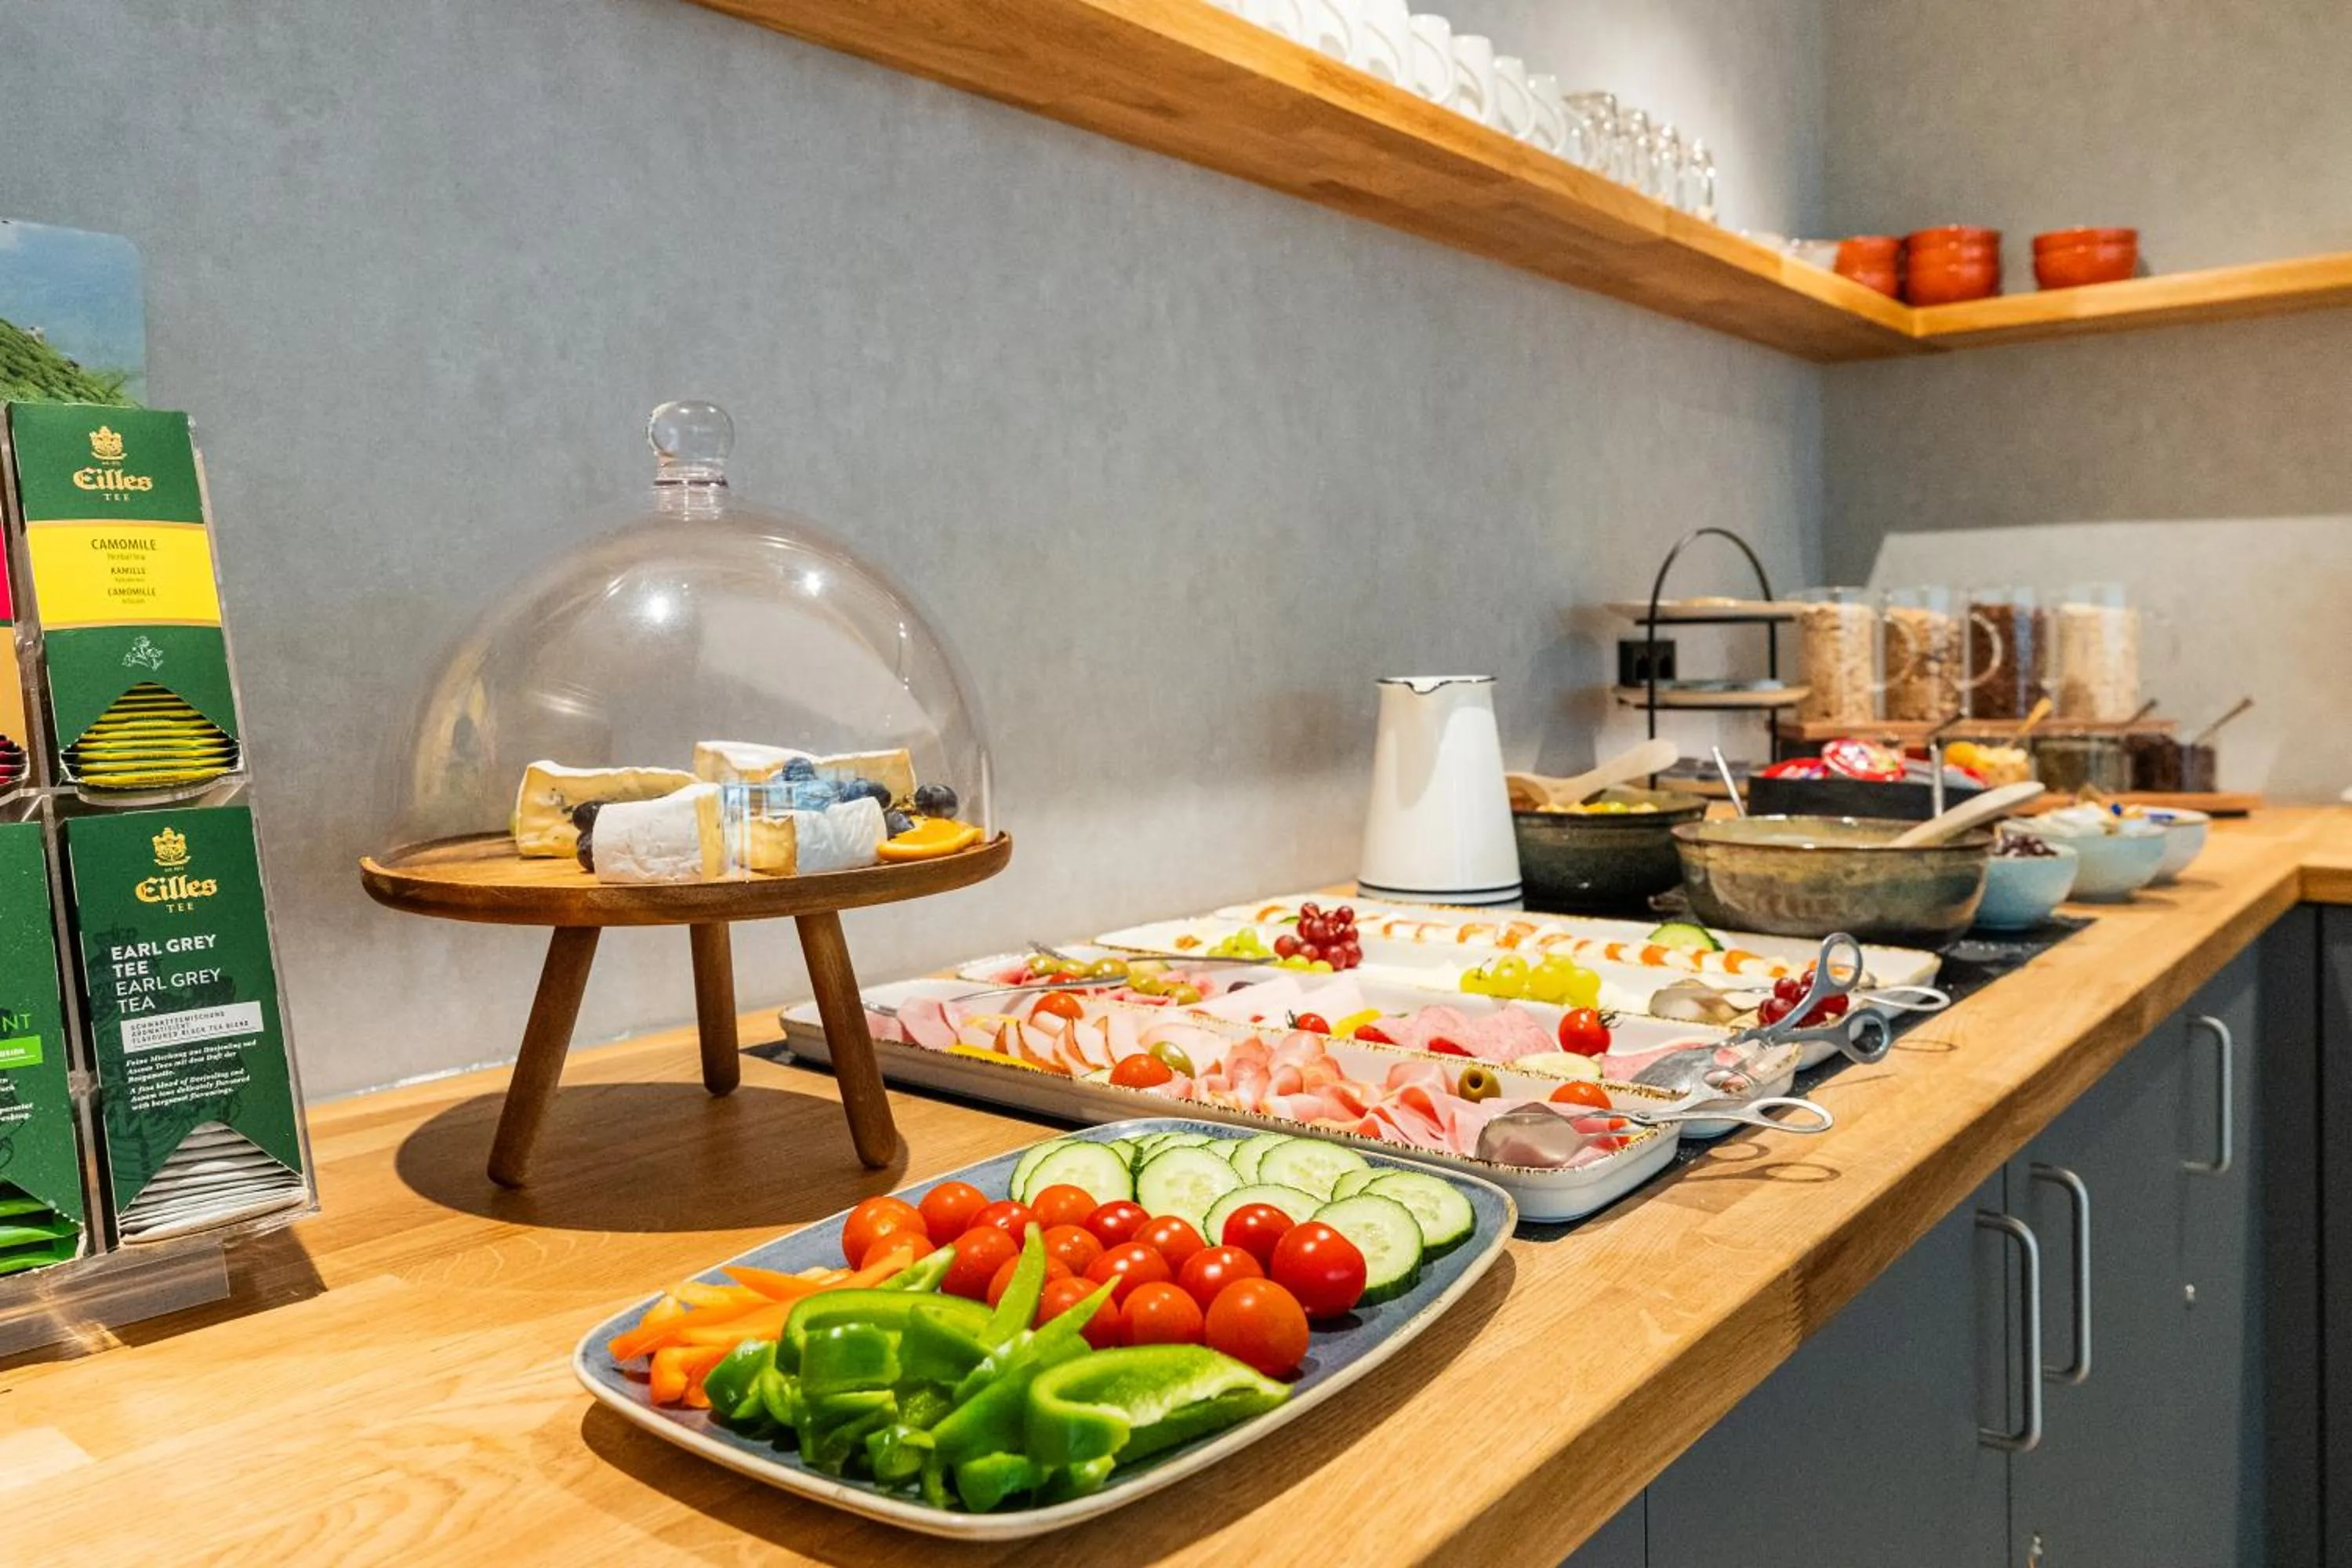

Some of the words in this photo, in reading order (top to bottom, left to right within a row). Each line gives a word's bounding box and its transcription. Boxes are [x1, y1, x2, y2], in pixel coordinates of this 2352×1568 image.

[73, 467, 153, 491] Eilles
[103, 493, 129, 502] TEE
[91, 539, 157, 550] CAMOMILE
[107, 587, 157, 597] CAMOMILLE
[135, 875, 218, 902] Eilles
[165, 902, 194, 913] TEE
[111, 941, 162, 960] EARL
[165, 934, 216, 953] GREY
[112, 960, 149, 978] TEE
[115, 976, 167, 996] EARL
[170, 967, 221, 987] GREY
[117, 996, 156, 1014] TEA
